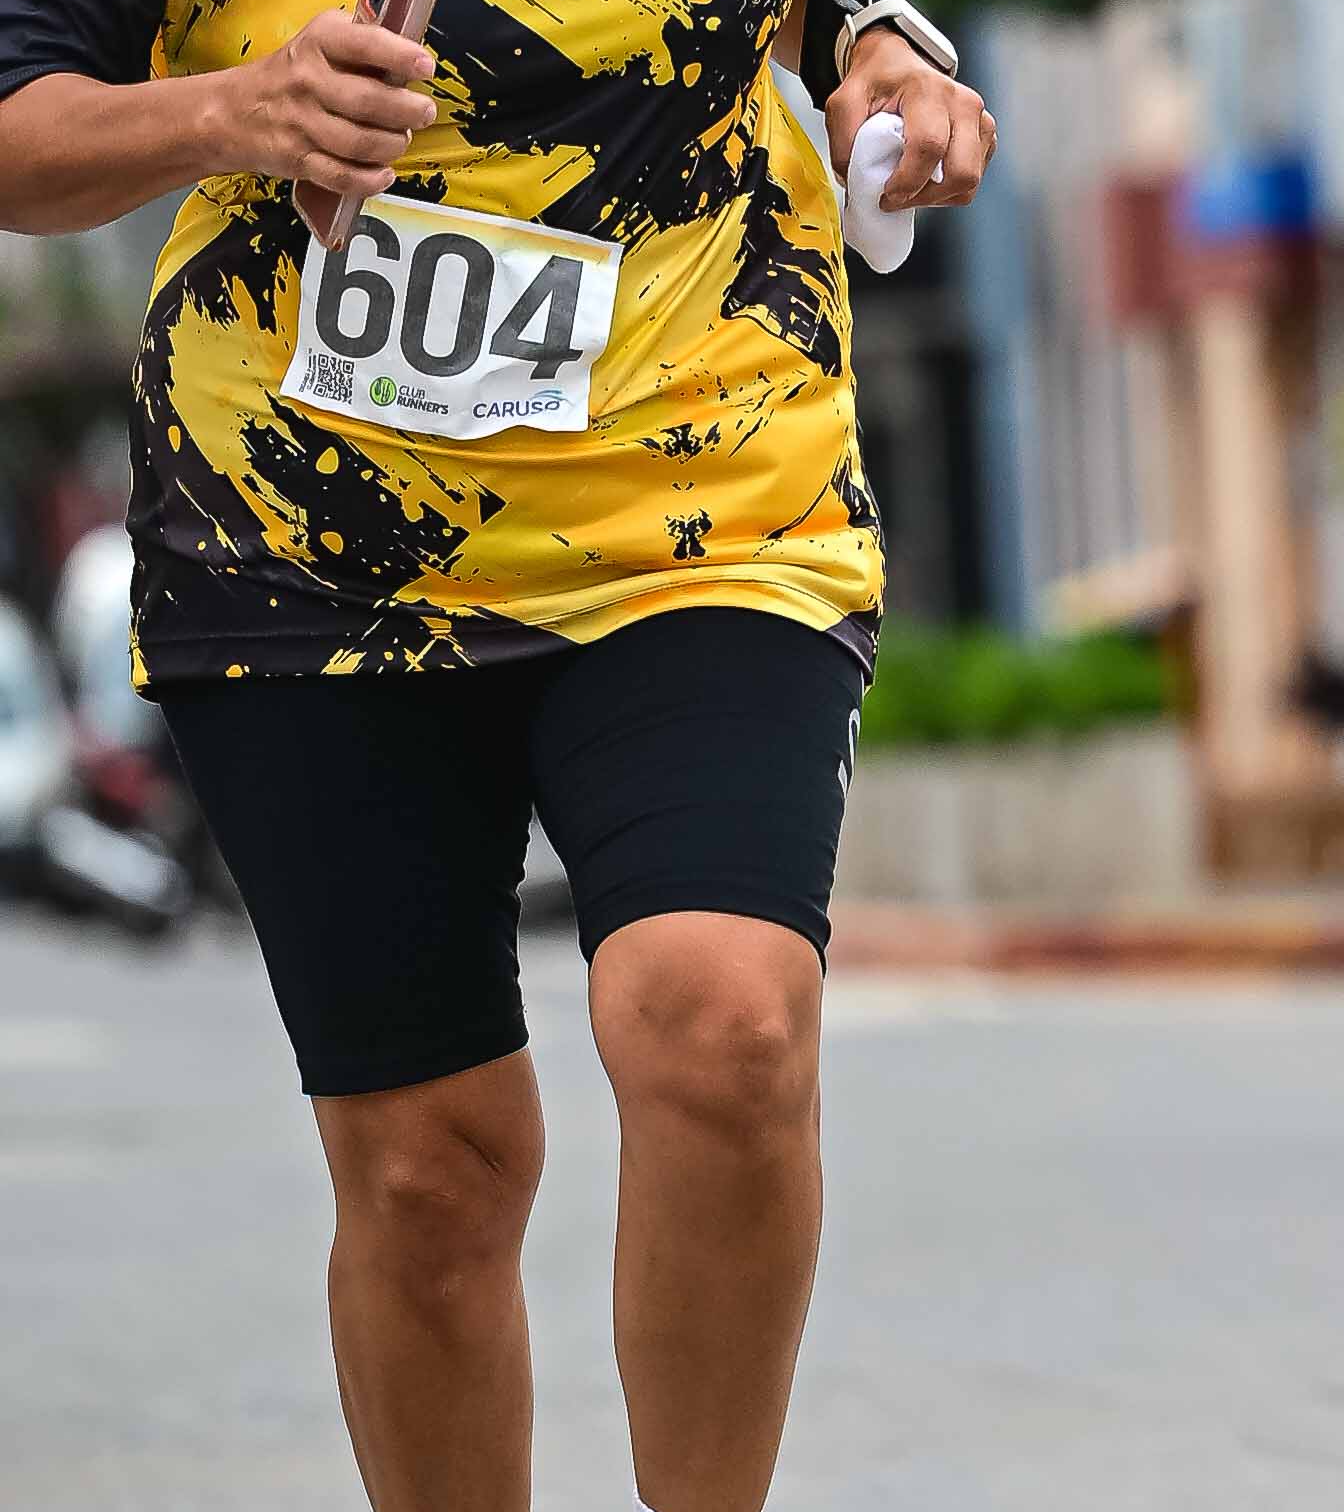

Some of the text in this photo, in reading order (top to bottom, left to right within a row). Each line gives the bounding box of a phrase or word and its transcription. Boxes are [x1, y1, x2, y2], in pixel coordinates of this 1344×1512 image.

[315, 214, 584, 381] 604
[398, 384, 426, 400] CLUB
[472, 399, 560, 419] CARUSO
